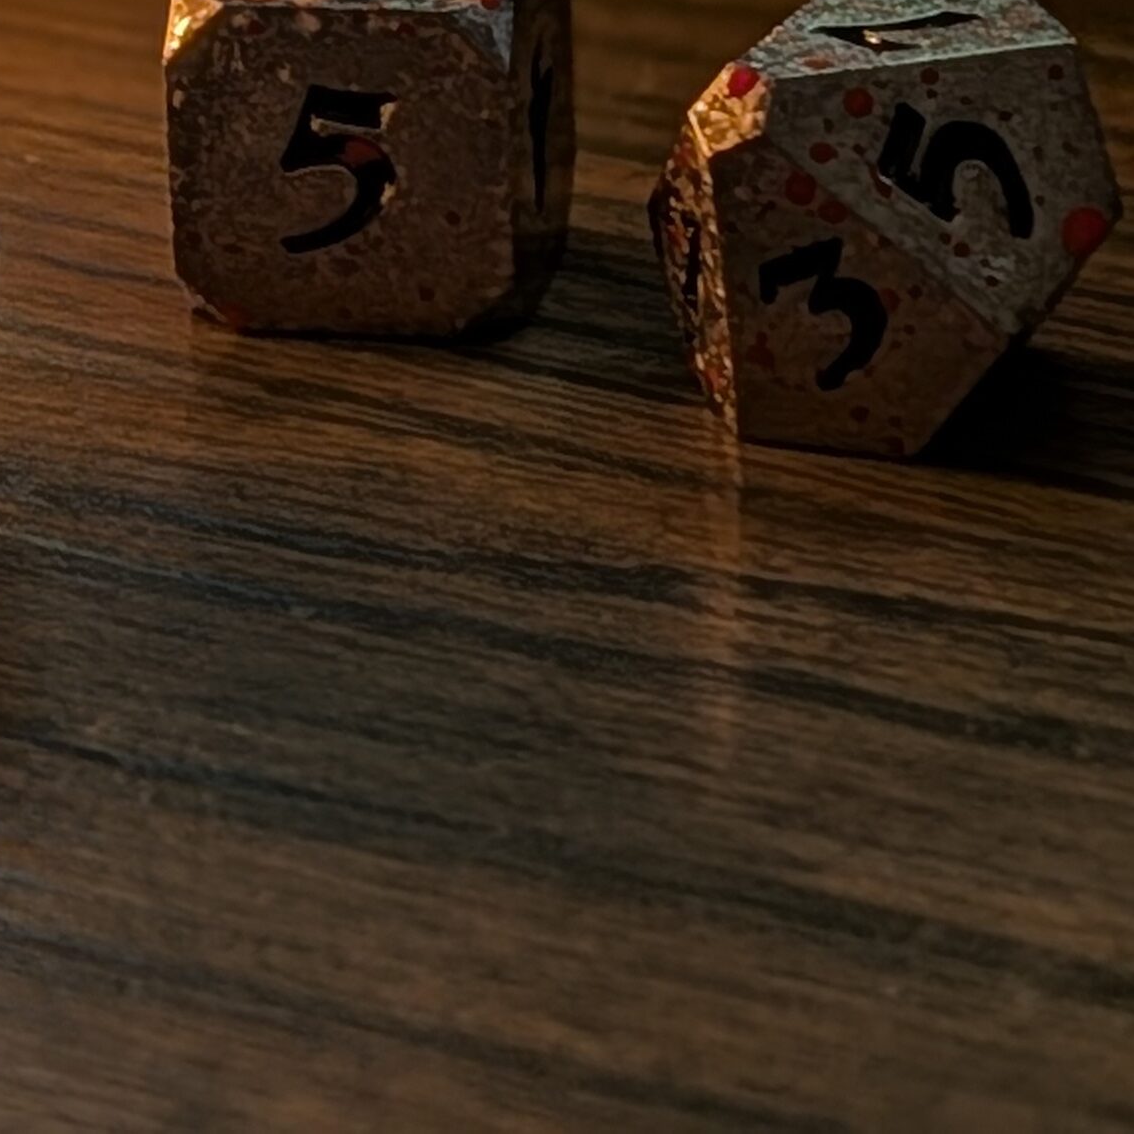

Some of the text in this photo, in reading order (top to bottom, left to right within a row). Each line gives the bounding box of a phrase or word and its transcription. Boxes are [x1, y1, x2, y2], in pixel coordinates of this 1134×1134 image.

[809, 11, 981, 52] 1
[281, 84, 398, 254] 5
[878, 102, 1034, 239] 5
[759, 237, 888, 391] 3
